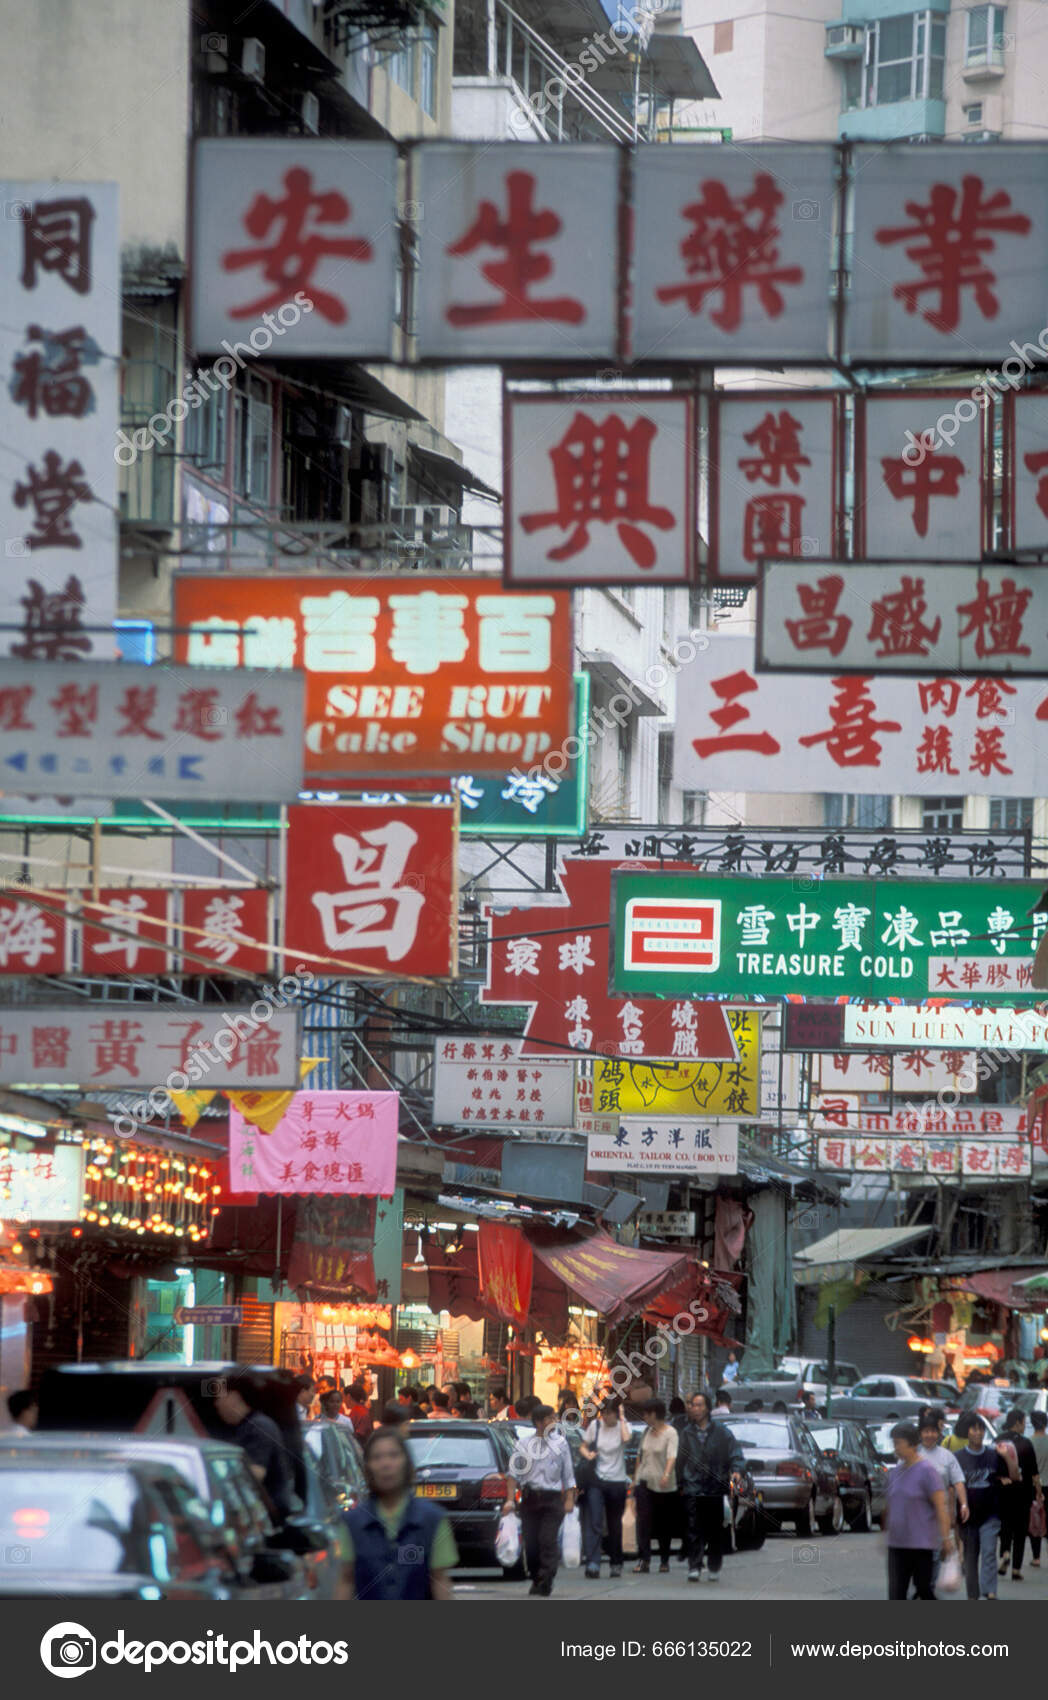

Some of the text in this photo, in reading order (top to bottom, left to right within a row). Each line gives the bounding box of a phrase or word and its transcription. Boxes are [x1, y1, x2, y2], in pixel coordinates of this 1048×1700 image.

[221, 166, 1032, 333] 安生藥業
[881, 433, 966, 538] 中
[326, 685, 425, 718] SEE
[305, 721, 551, 763] Cake Shop
[311, 820, 426, 961] 昌
[737, 953, 914, 978] TREASURE COLD
[856, 1021, 896, 1037] SUN
[911, 1022, 965, 1040] LUEN
[1032, 1025, 1048, 1042] F
[590, 1151, 634, 1160] ORIENTAL
[640, 1151, 672, 1161] TAILOR
